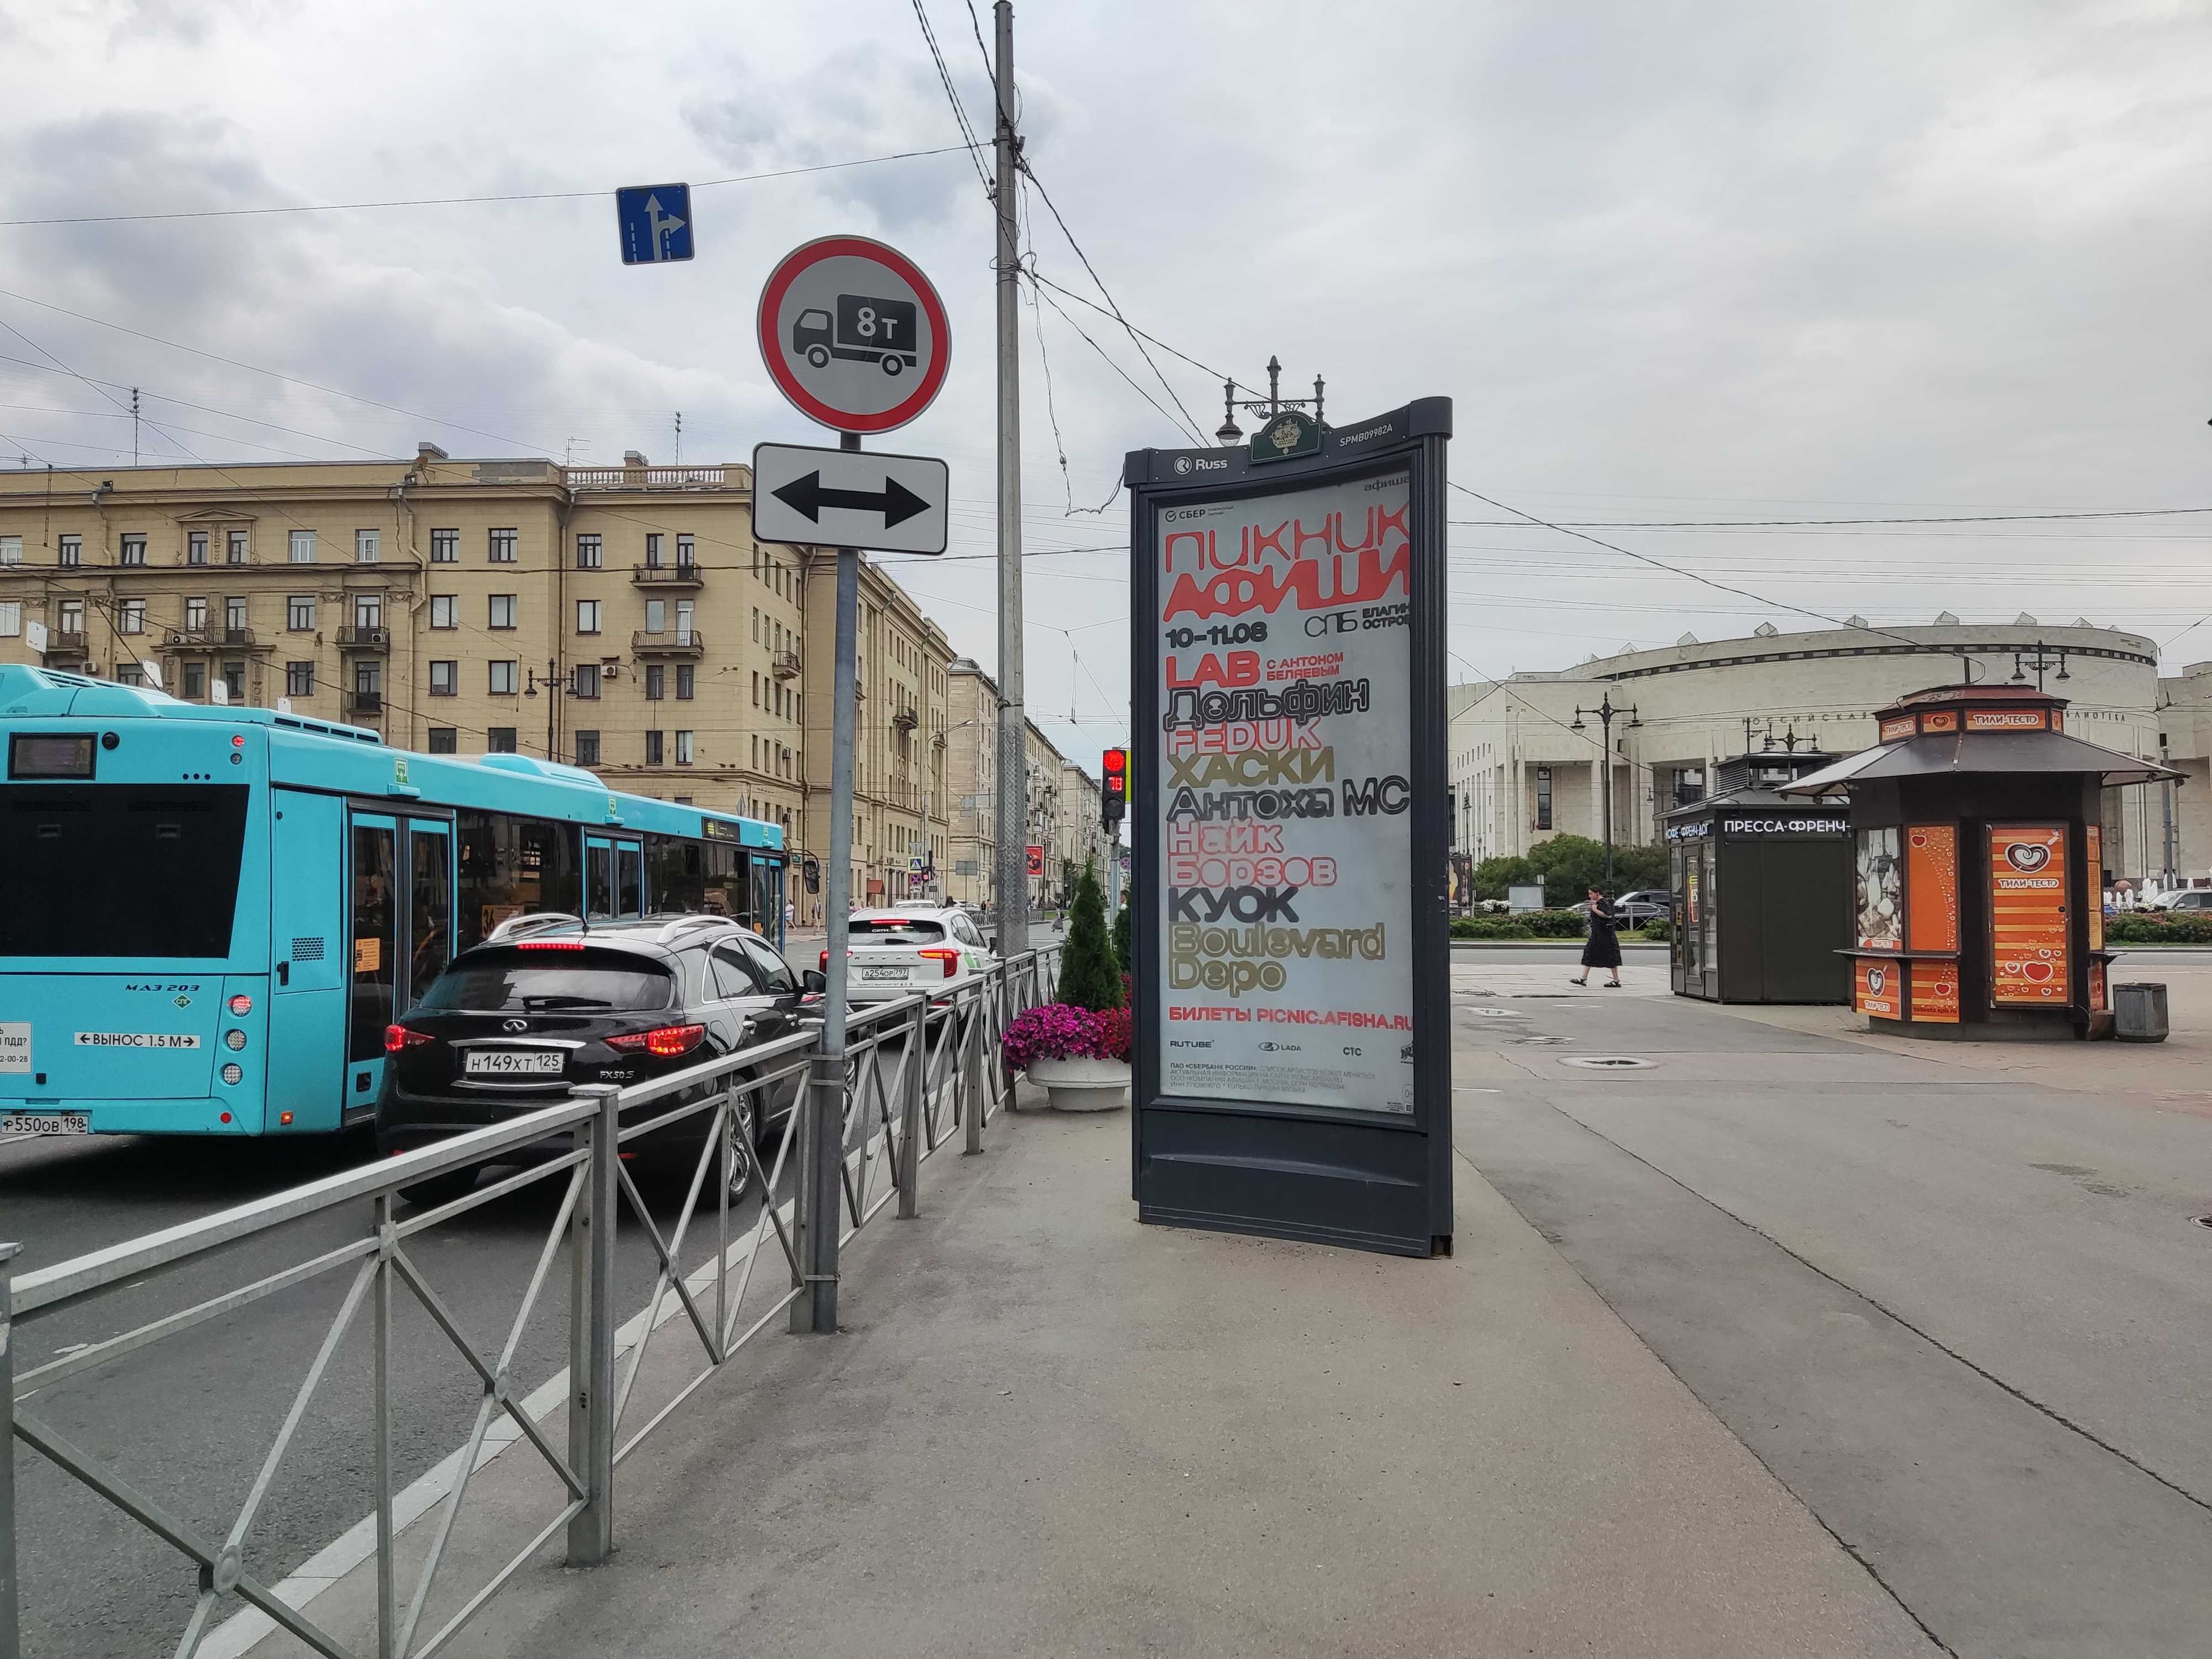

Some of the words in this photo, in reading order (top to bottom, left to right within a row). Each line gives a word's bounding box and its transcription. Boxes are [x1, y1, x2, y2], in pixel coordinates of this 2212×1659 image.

[1339, 423, 1393, 447] SPMB09982A
[1195, 459, 1228, 471] Russ
[1364, 476, 1410, 491] афиша
[1179, 509, 1206, 519] СБЕР
[1165, 504, 1410, 573] ПИКНИК
[1162, 543, 1410, 622] АФИШИ
[1304, 610, 1358, 638] СПБ
[1165, 622, 1267, 649] 10-11.08
[1267, 659, 1277, 669] С
[1280, 652, 1344, 669] АНТОНОМ
[1166, 650, 1260, 691] LAB
[1267, 665, 1340, 681] БЕЛЯЕВЫМ
[1742, 712, 1867, 726] РОССИЙСКАЯ
[1974, 715, 2038, 724] ТИЛИ-ТЕСТО
[2066, 711, 2125, 721] БЛИОТЕКА
[1166, 715, 1323, 756] FEDUK
[1167, 746, 1335, 789] ХАСКИ
[1166, 816, 1285, 855] Найк
[1168, 853, 1338, 888] Борзов
[1999, 879, 2058, 888] ТИЛИ-ТЕСТО
[1168, 922, 1385, 960] Boulevard
[1168, 955, 1287, 998] Depo
[1169, 1006, 1251, 1022] БИЛЕТЫ
[1257, 1008, 1413, 1031] PICNIC.AFISHA.RU
[5, 1037, 27, 1047] ПДД?
[93, 1034, 143, 1046] ВЫНОС
[149, 1035, 165, 1047] 1.5
[170, 1036, 181, 1047] М
[1343, 1047, 1362, 1056] СТС
[536, 1055, 559, 1066] 125
[63, 1118, 84, 1128] 198
